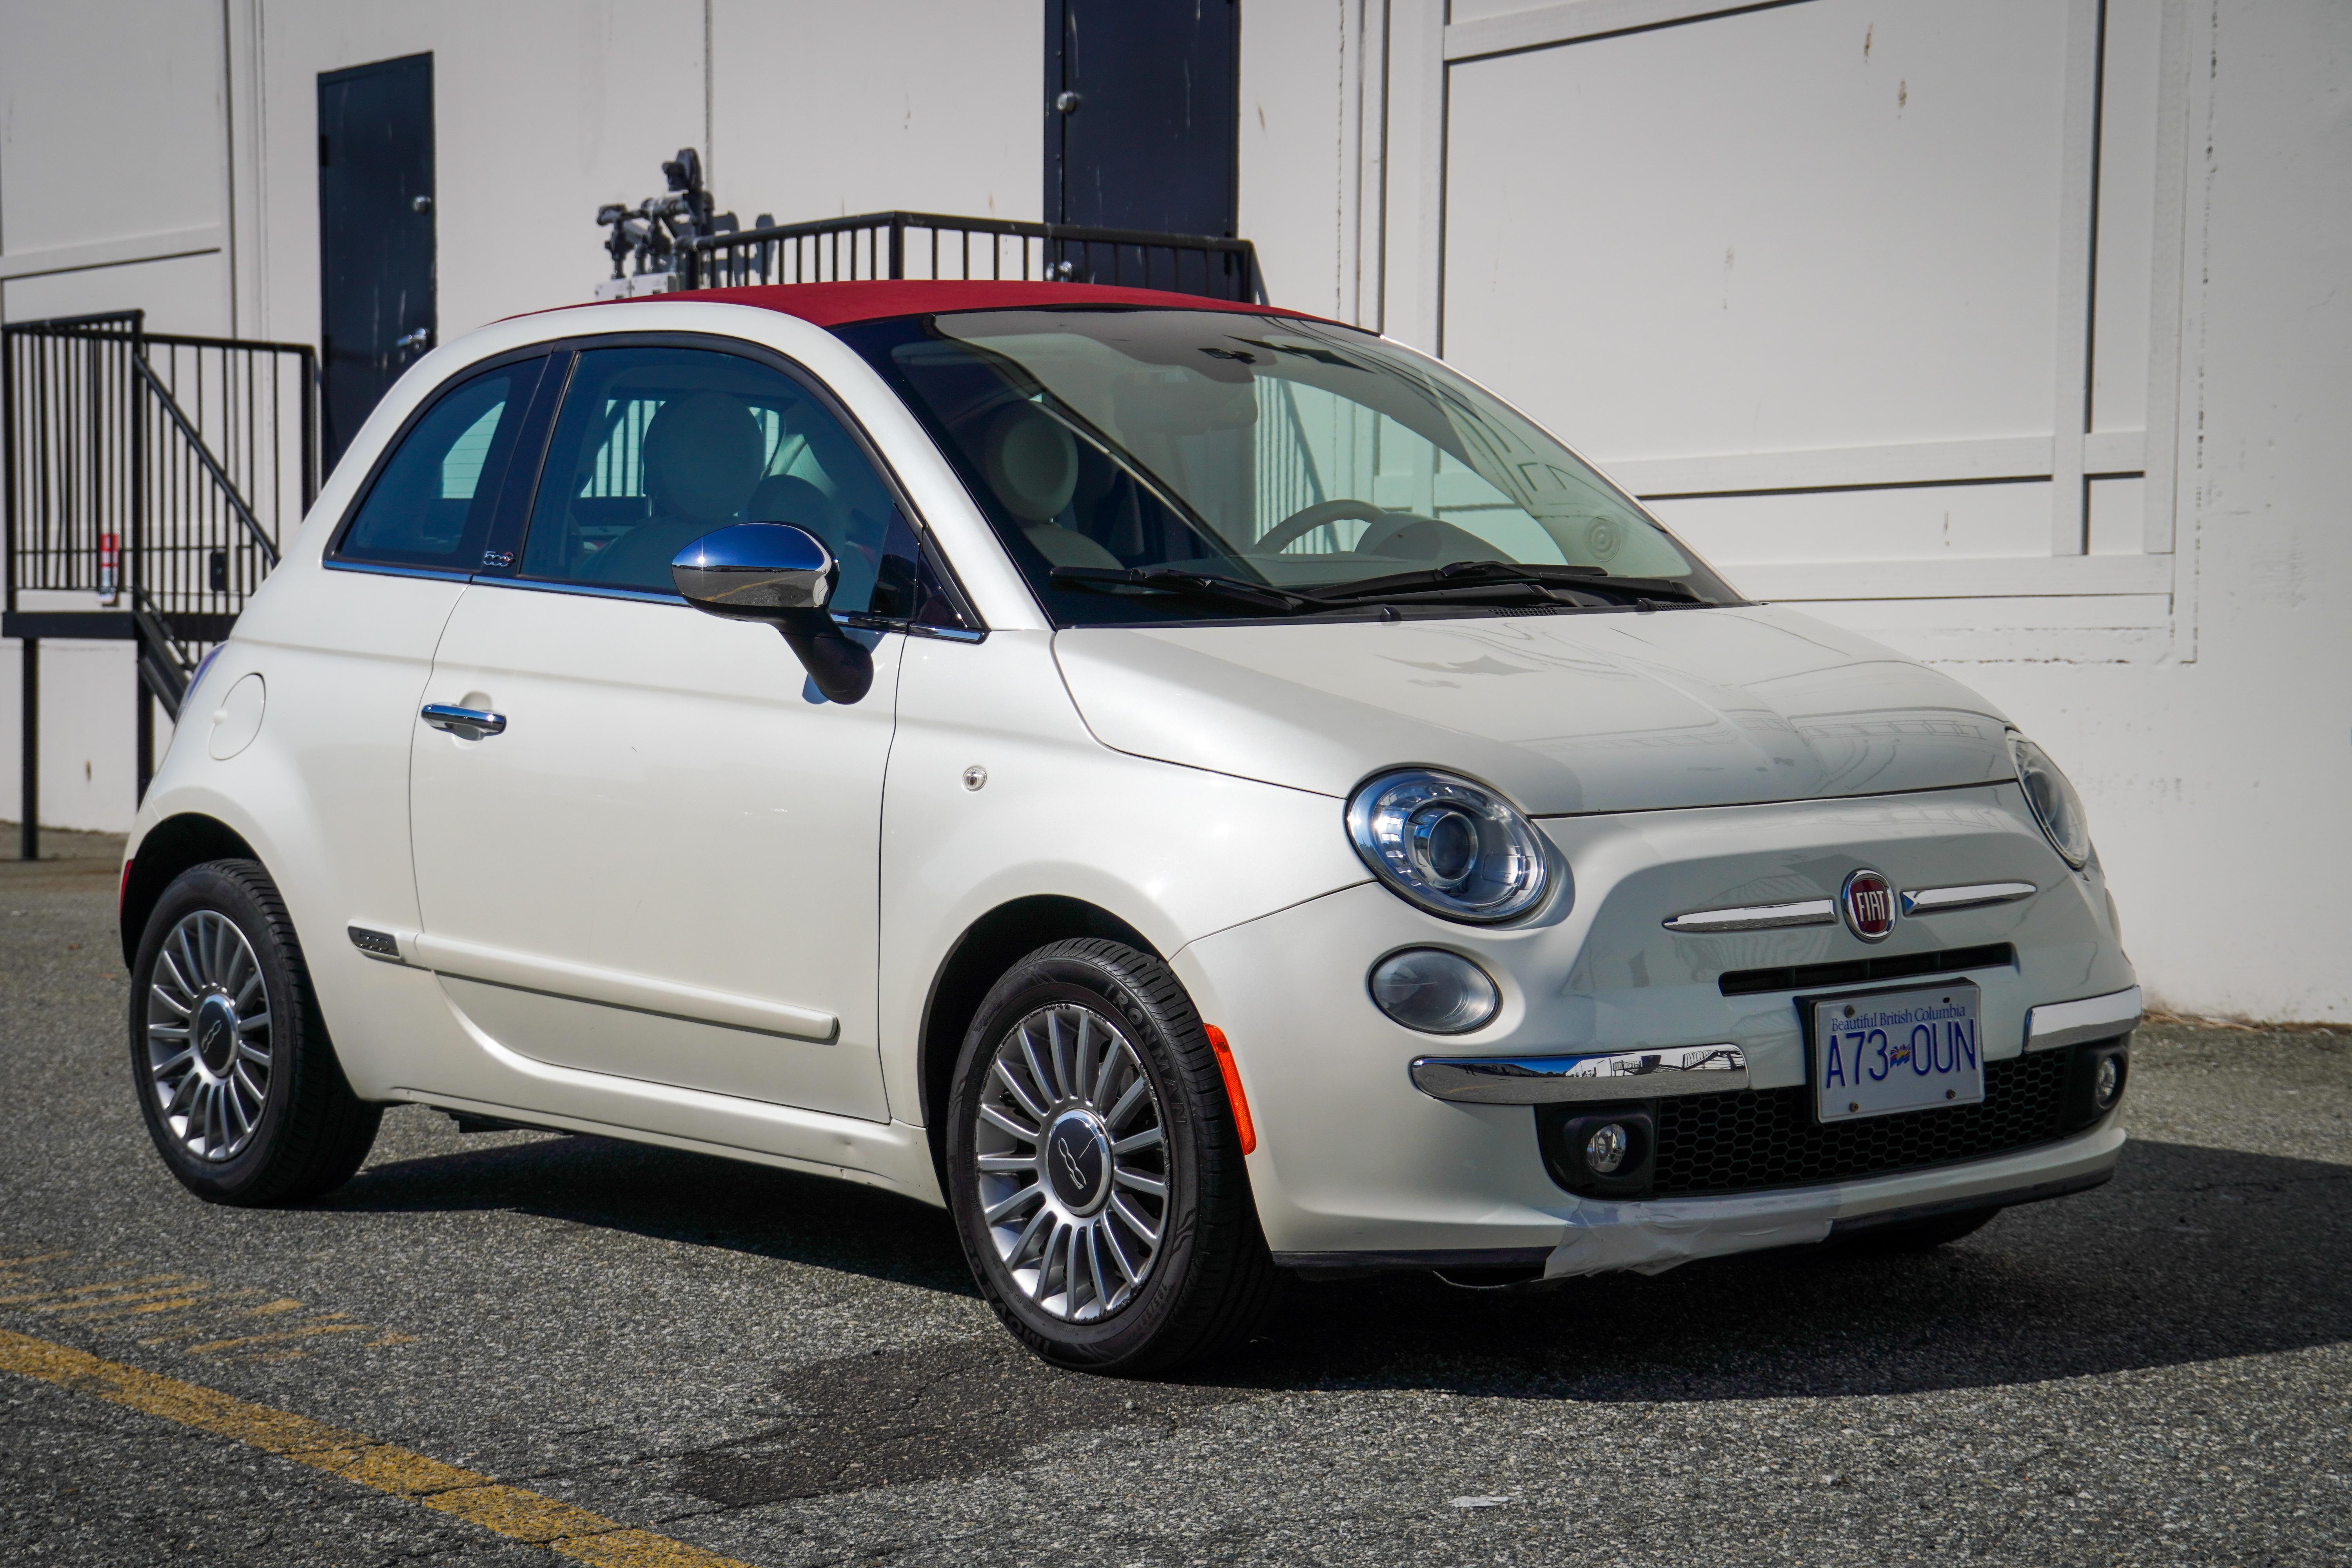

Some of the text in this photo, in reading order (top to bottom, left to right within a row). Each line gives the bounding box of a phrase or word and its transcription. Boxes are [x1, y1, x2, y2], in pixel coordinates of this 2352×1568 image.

[1856, 890, 1885, 922] FIAT
[359, 931, 389, 951] 500
[1831, 1004, 1965, 1031] Beautiful British Columbia
[1104, 983, 1187, 1123] IRONMAN
[1826, 1027, 1889, 1089] A73
[968, 1176, 979, 1212] TUBELESS
